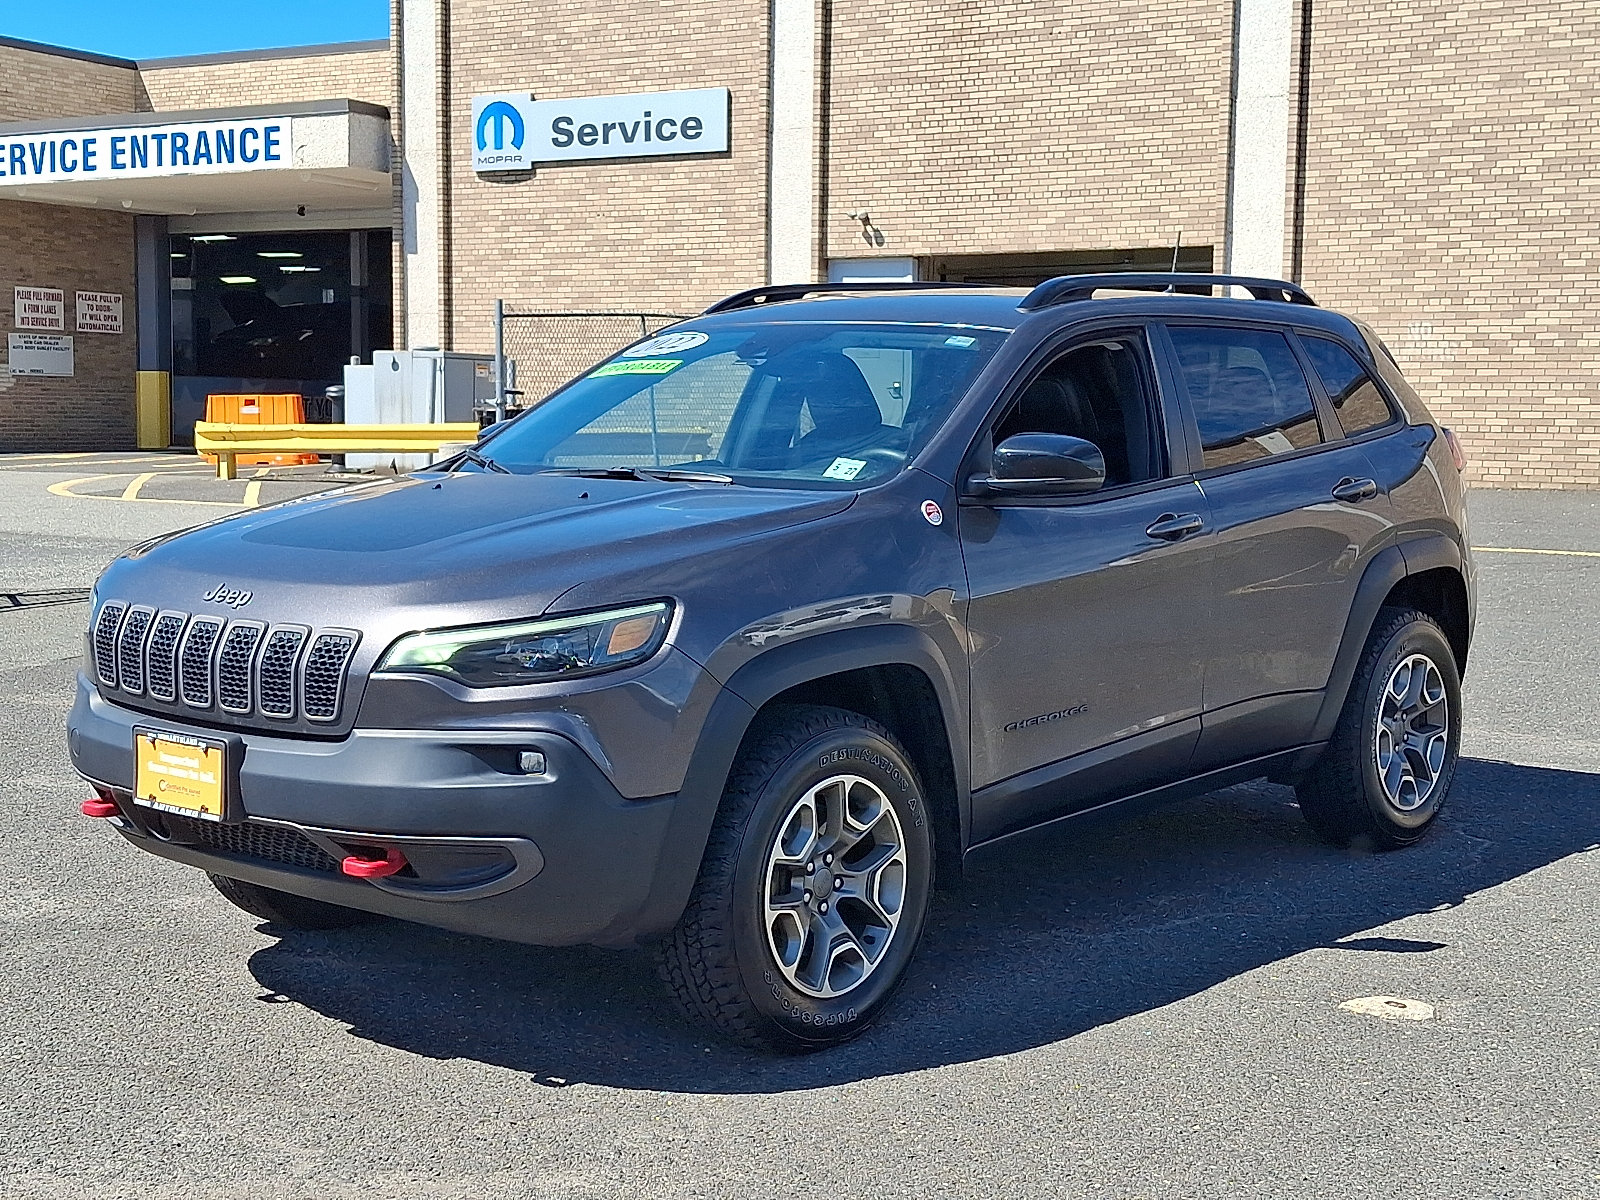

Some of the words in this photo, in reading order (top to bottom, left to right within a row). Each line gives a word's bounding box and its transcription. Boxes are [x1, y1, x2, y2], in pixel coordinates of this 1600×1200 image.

[551, 110, 703, 148] Service
[111, 125, 281, 170] ENTRANCE
[477, 155, 523, 165] MOPAR
[17, 290, 32, 301] PLEASE
[33, 291, 42, 301] PULL
[43, 292, 62, 302] FORWARD
[78, 293, 98, 303] PLEASE
[99, 295, 113, 303] PULL
[113, 296, 121, 304] UP
[28, 303, 39, 313] FORM
[44, 304, 57, 315] LANES
[87, 303, 94, 312] TO
[31, 317, 47, 326] SERVICE
[82, 313, 87, 321] IT
[89, 313, 102, 322] WILL
[103, 314, 118, 322] OPEN
[78, 322, 121, 332] AUTOMATICALLY
[203, 582, 254, 610] Jeep
[1003, 703, 1089, 733] CHEROKEE
[818, 748, 910, 792] DESTINATION
